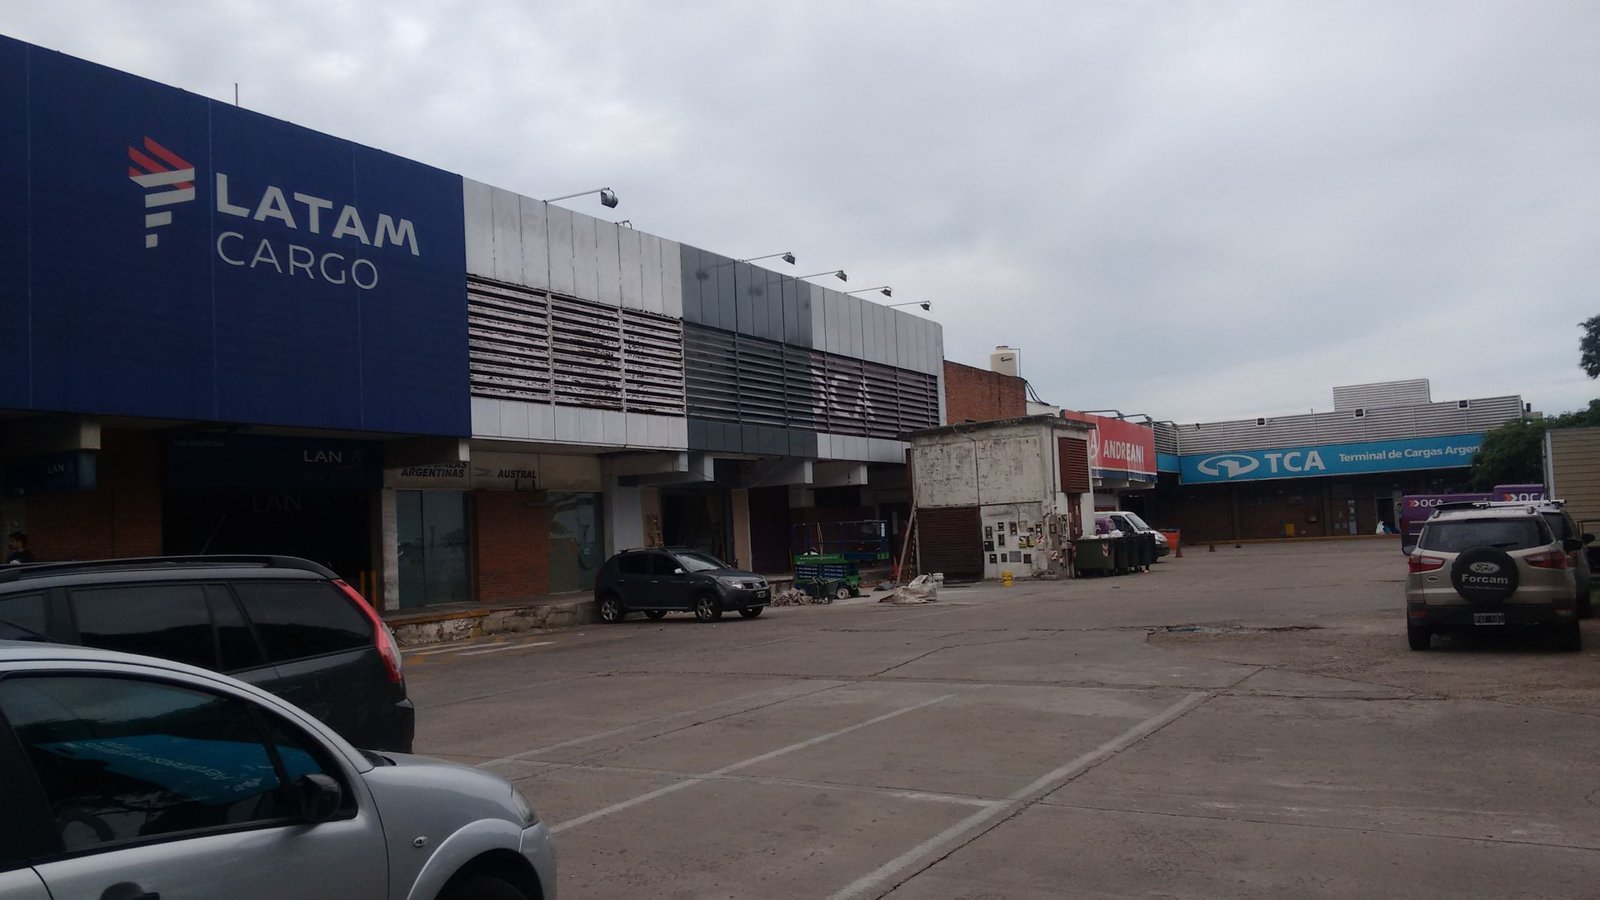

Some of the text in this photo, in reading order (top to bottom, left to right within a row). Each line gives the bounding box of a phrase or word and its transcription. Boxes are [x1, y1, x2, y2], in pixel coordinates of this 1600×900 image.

[216, 172, 420, 257] LATAM
[216, 231, 378, 290] CARGO
[303, 449, 342, 464] LAN
[1103, 439, 1144, 464] ANDREANI
[1339, 450, 1386, 462] Terminal
[1388, 449, 1402, 459] de
[1404, 447, 1443, 459] Cargas
[48, 464, 65, 474] LAN
[1264, 450, 1326, 473] TCA
[401, 467, 465, 478] ARGENTINAS
[497, 469, 537, 479] AUSTRAL
[1461, 573, 1509, 585] Forcam
